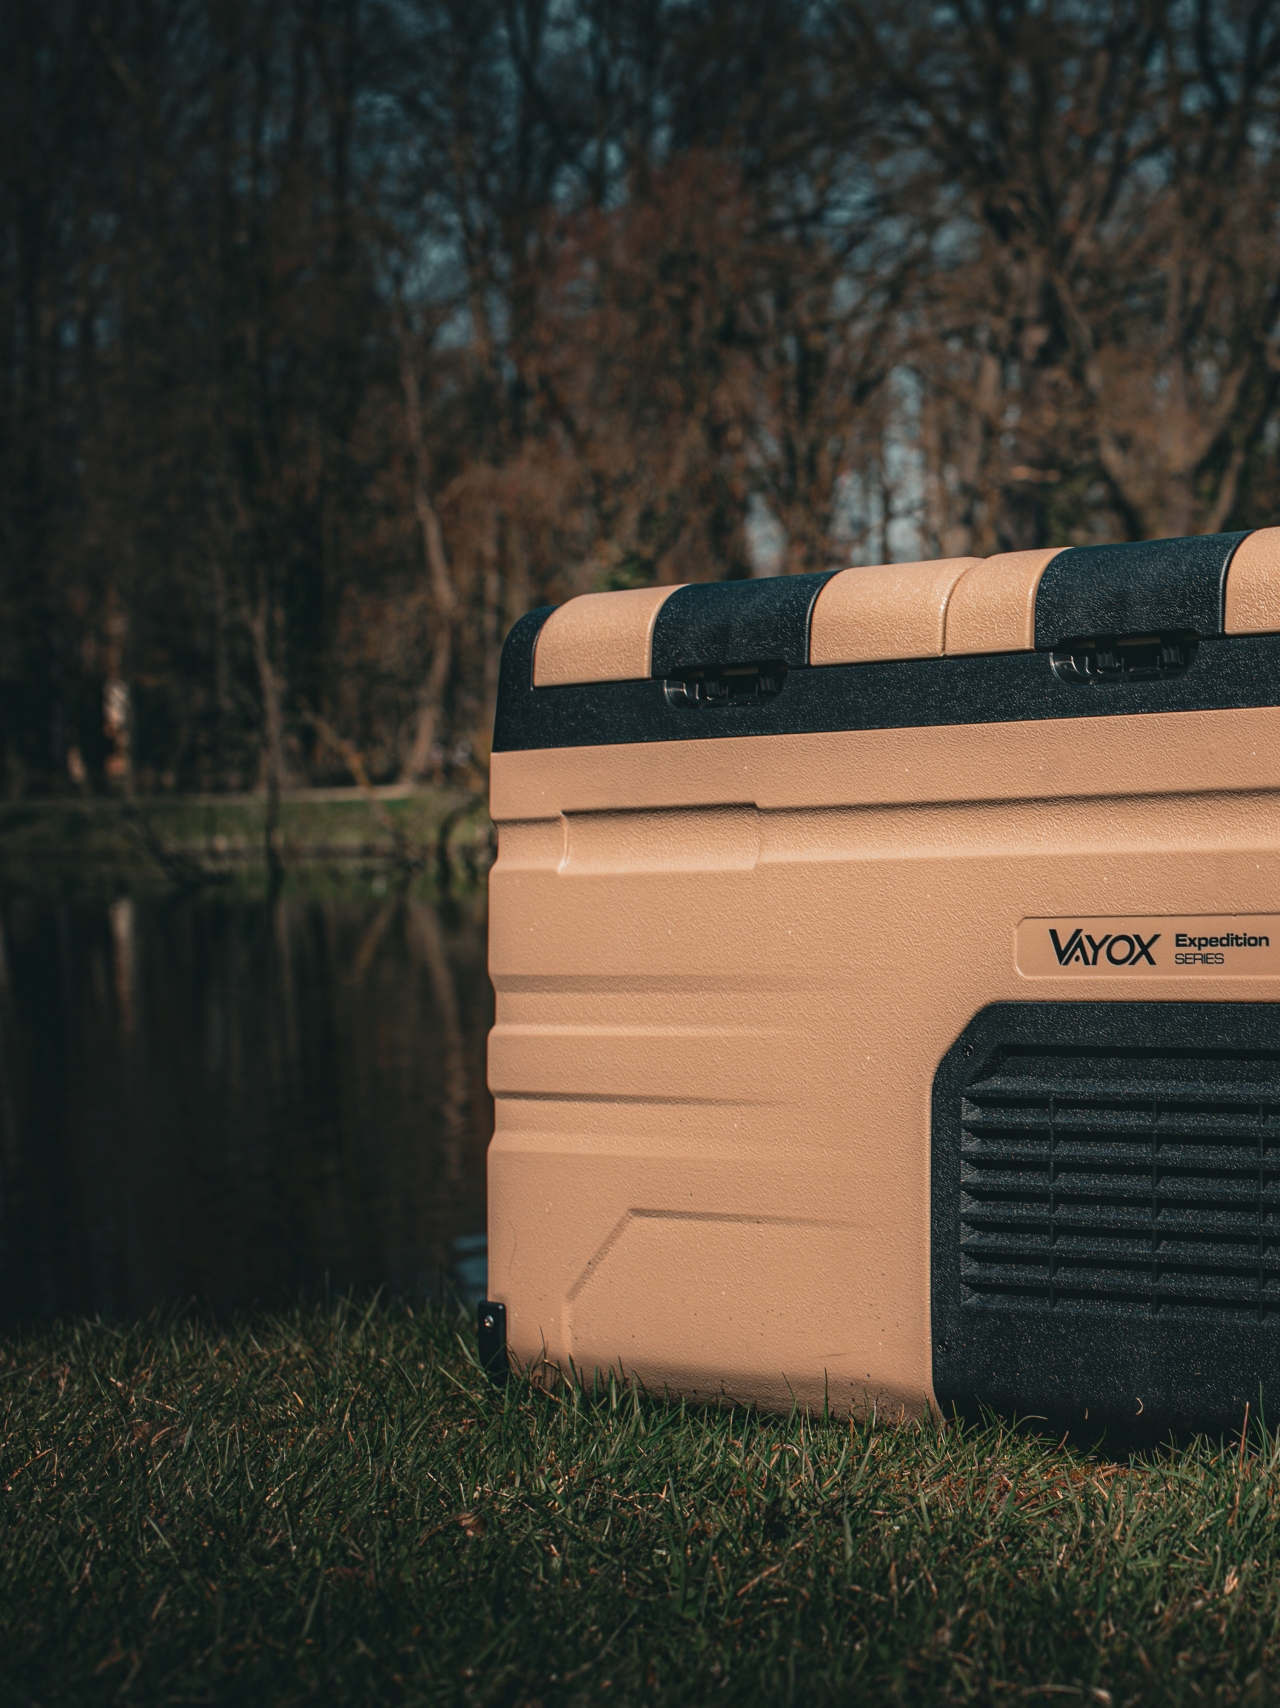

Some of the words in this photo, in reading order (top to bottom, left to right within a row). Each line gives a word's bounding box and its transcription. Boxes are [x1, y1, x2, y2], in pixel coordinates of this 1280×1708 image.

[1048, 929, 1162, 966] VAYOX
[1174, 933, 1270, 951] Expedition
[1174, 953, 1225, 965] SERIES
